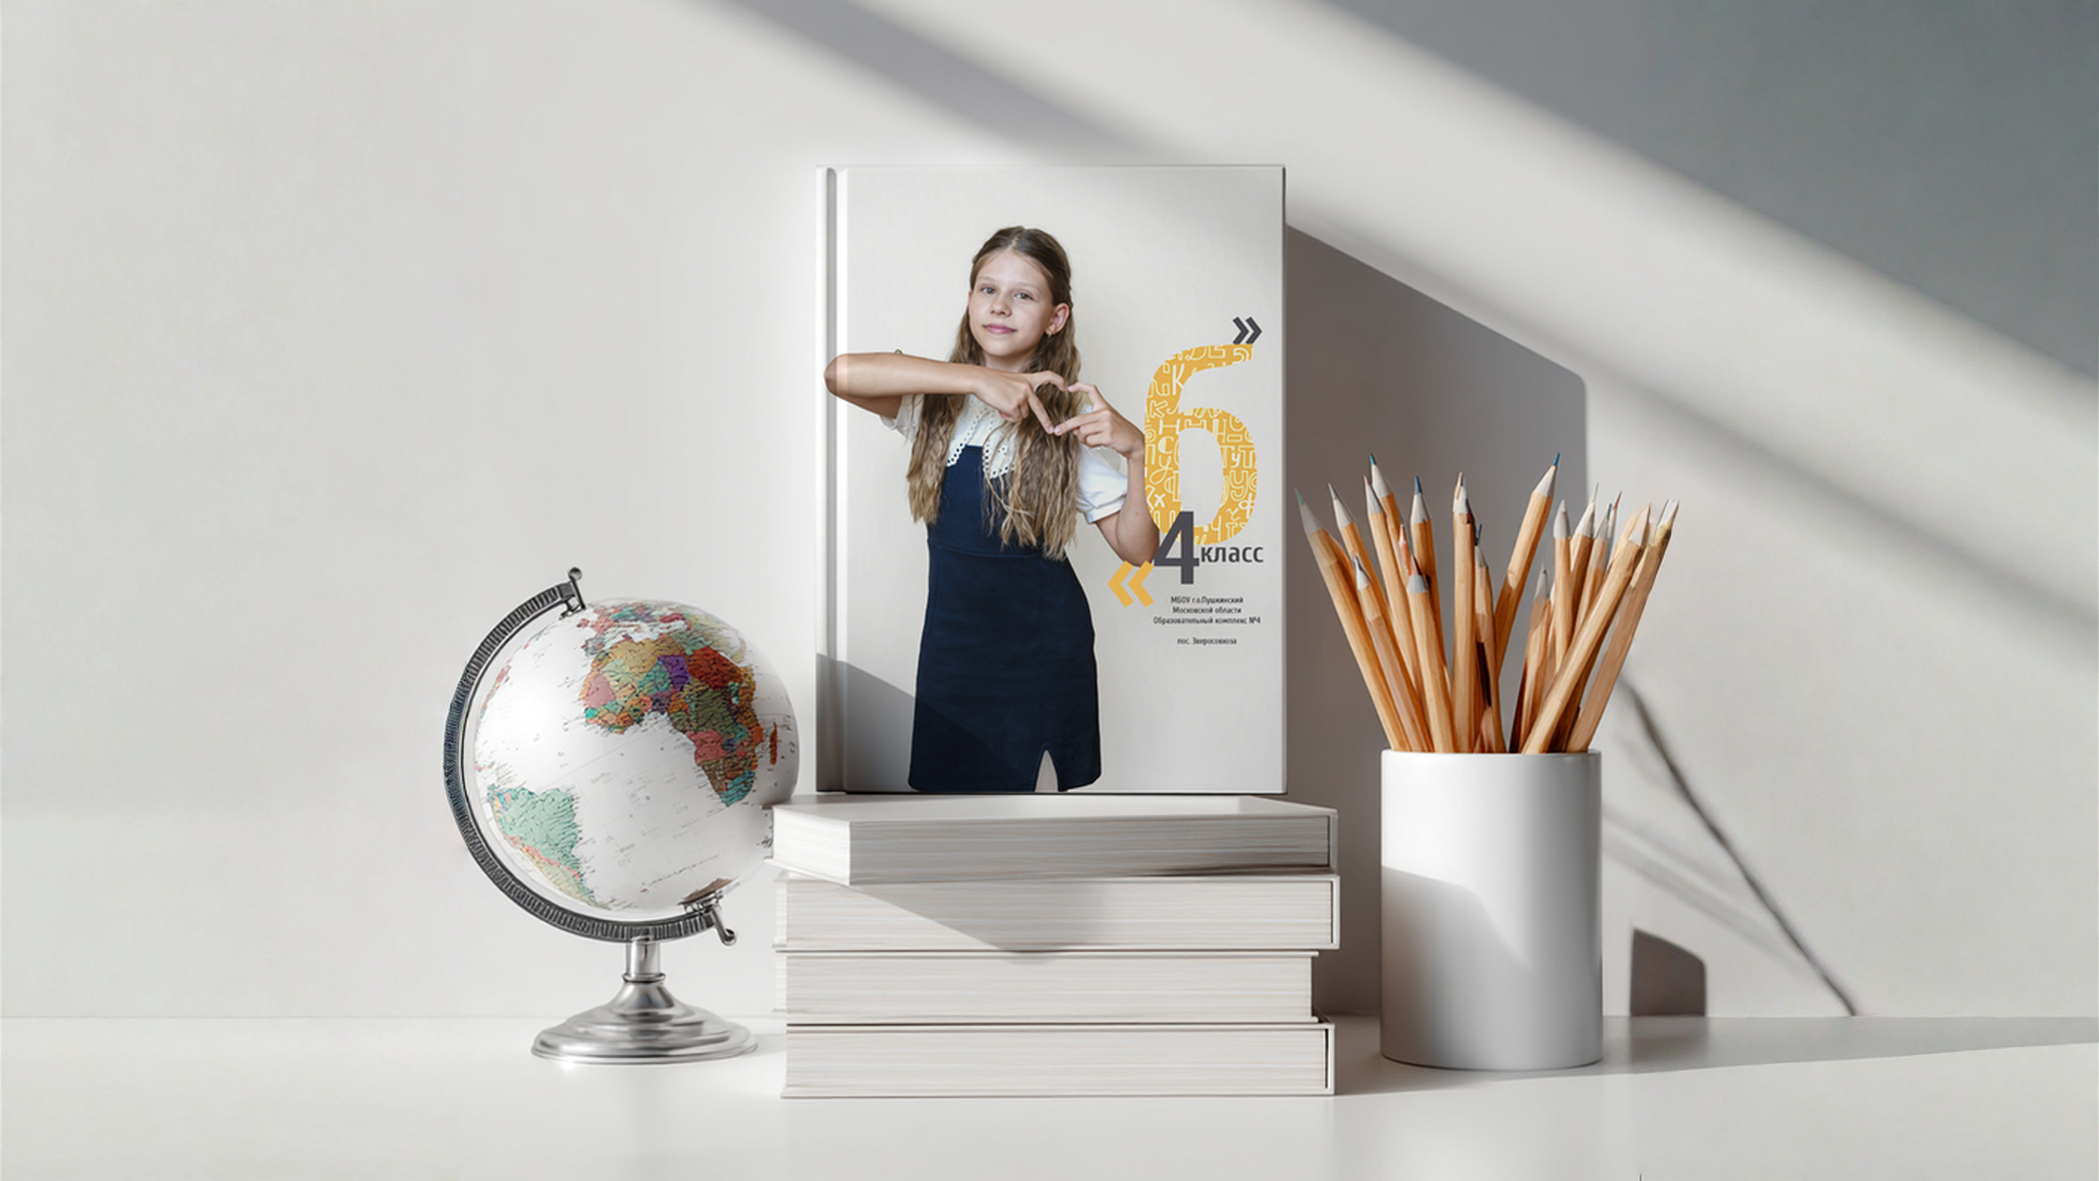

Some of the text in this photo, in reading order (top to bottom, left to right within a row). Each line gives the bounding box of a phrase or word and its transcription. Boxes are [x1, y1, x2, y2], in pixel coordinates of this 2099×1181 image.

[1153, 511, 1264, 585] 4 класс
[1170, 596, 1190, 604] МБОУ
[1172, 606, 1242, 614] Московской области
[1153, 616, 1213, 625] Образовательный
